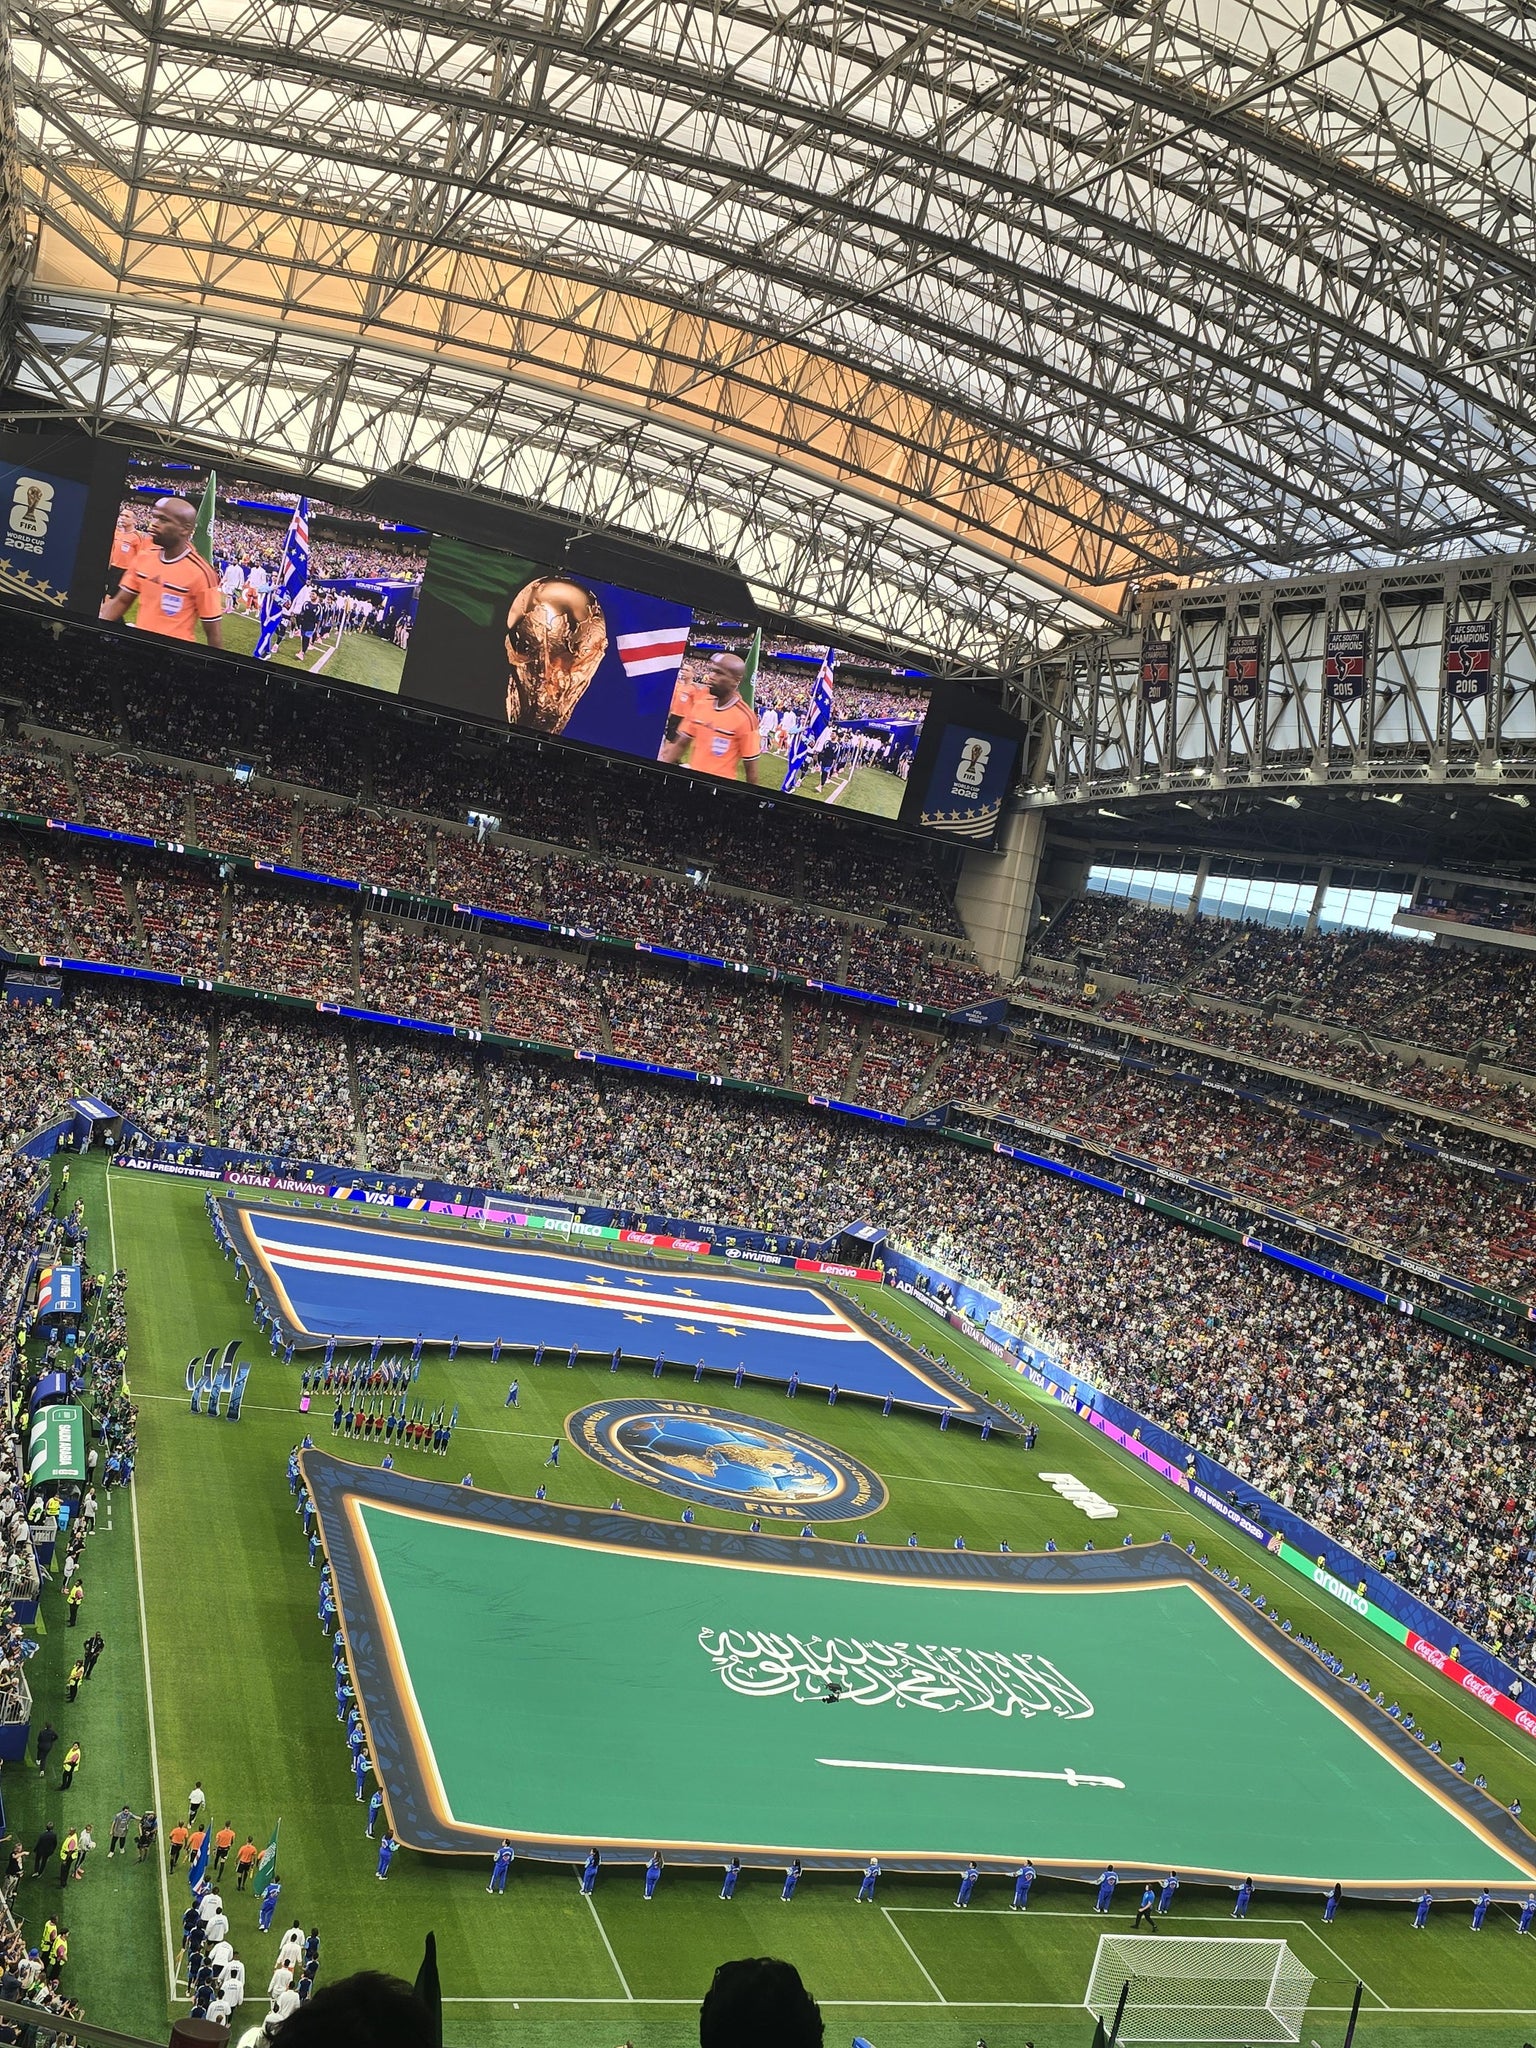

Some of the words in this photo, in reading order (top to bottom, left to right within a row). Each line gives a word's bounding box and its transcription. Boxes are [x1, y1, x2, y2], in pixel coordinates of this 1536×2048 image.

[20, 521, 37, 532] FIFA
[7, 531, 31, 543] WORLD
[31, 538, 45, 546] CUP
[4, 538, 44, 555] 2026
[1455, 626, 1466, 634] AFC
[1466, 624, 1486, 633] SOUTH
[1450, 632, 1489, 644] CHAMPIONS
[1229, 646, 1257, 655] CHAMPIONS
[1328, 641, 1363, 651] CHAMPIONS
[1233, 684, 1249, 696] 2012
[1333, 683, 1354, 696] 2015
[1455, 679, 1478, 693] 2016
[963, 773, 976, 782] FIFA
[950, 787, 978, 799] 2026
[953, 782, 970, 790] WORLD
[1201, 1080, 1235, 1094] HOUSTON
[126, 1158, 152, 1170] ADI
[1156, 1167, 1190, 1184] HOUSTON
[229, 1172, 271, 1188] QATAR
[274, 1178, 326, 1196] AIRWAYS
[365, 1191, 395, 1206] VISA
[544, 1218, 603, 1237] aramco
[698, 1225, 715, 1235] FIFA
[741, 1251, 782, 1265] HYUNDAI
[819, 1263, 858, 1278] Lenovo
[1400, 1259, 1441, 1280] HOUSTON
[895, 1280, 915, 1296] ADI
[961, 1322, 981, 1342] QATAR
[980, 1335, 1005, 1359] AIRWAYS
[1028, 1366, 1046, 1389] VISA
[1060, 1389, 1078, 1412] VISA
[656, 1403, 711, 1416] FIFA
[59, 1424, 71, 1442] SAUDI
[59, 1442, 72, 1466] ARABIA
[744, 1502, 807, 1517] FIFA
[1193, 1485, 1207, 1502] FIFA
[1206, 1494, 1229, 1516] WORLD
[1227, 1510, 1240, 1523] CUP
[1313, 1567, 1369, 1616] aramco
[1413, 1640, 1449, 1671] Coca-Cola
[1462, 1673, 1501, 1706] Coca-Cola
[1515, 1710, 1536, 1738] Coca-
